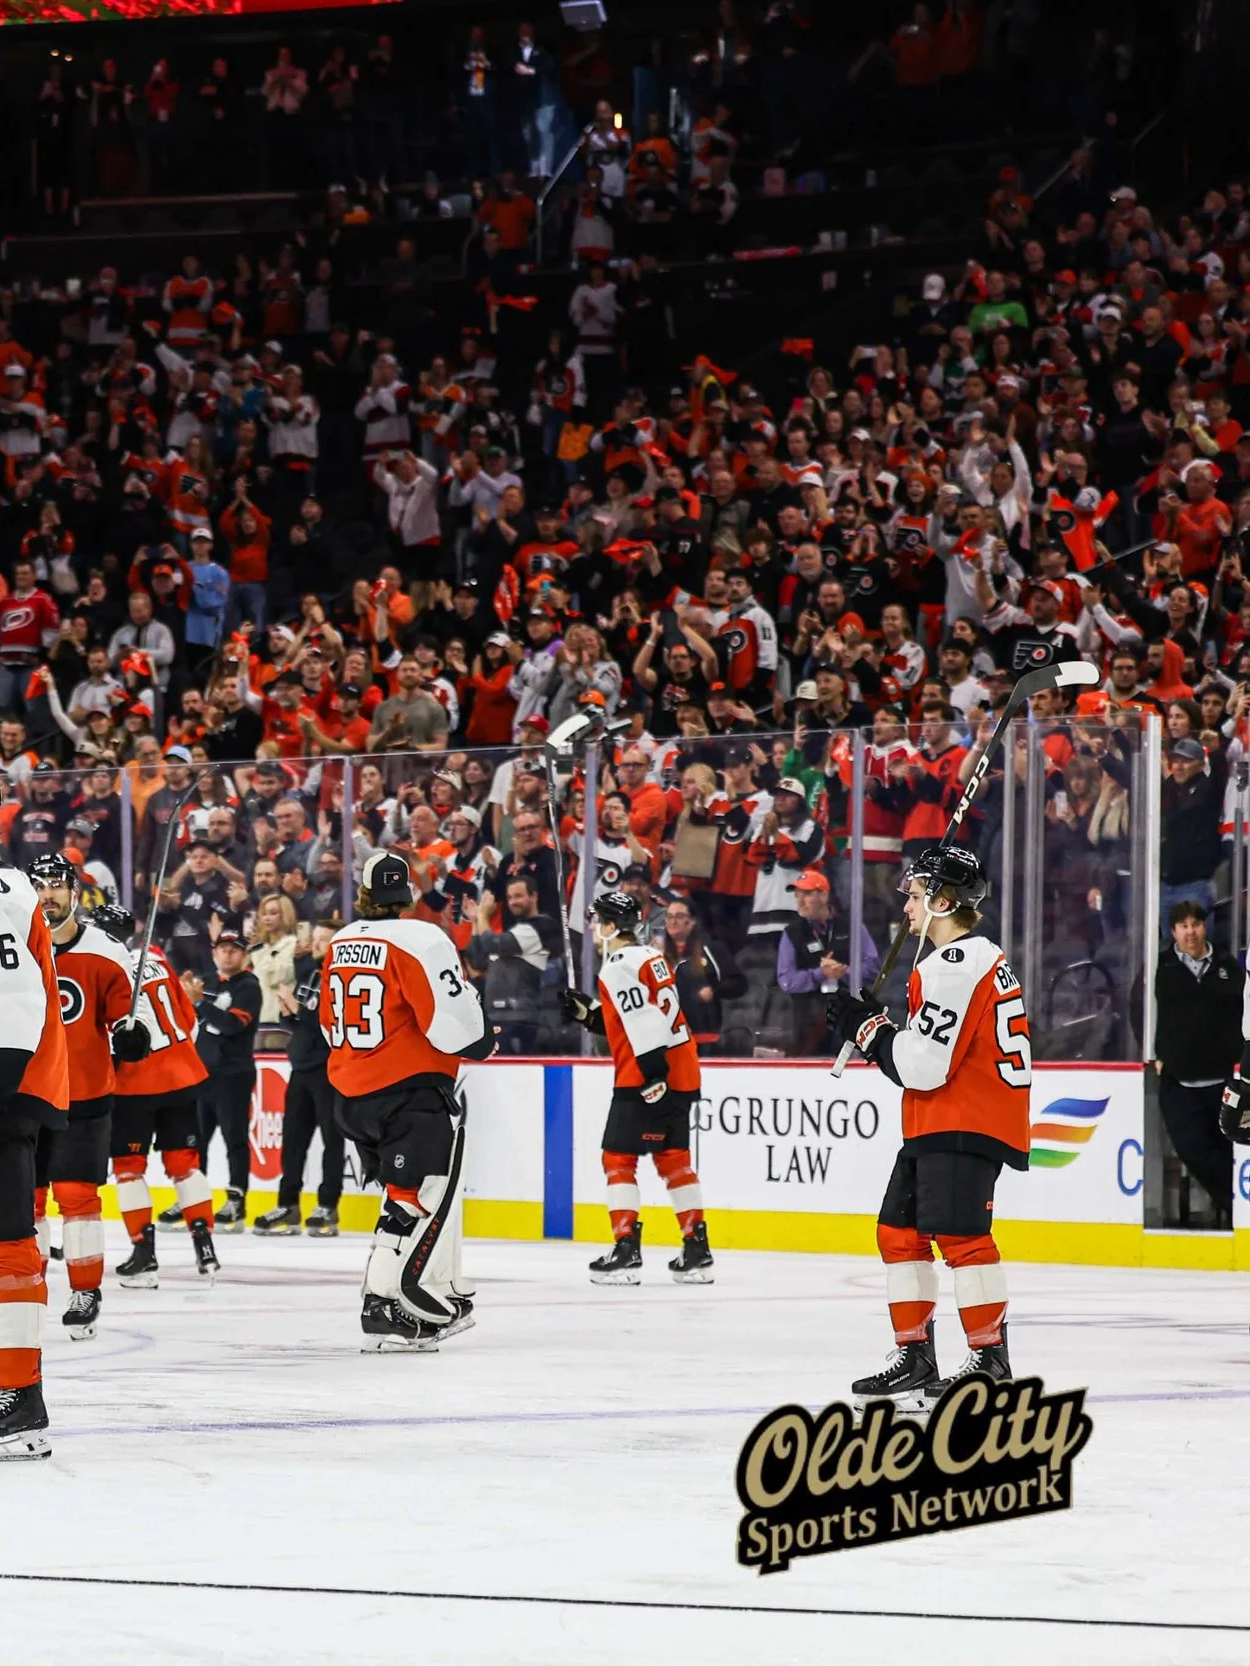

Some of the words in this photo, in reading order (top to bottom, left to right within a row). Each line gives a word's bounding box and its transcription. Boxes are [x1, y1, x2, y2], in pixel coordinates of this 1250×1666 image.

[953, 754, 989, 824] CCM
[333, 944, 382, 966] RSSON
[617, 986, 644, 1013] 20
[918, 1001, 958, 1046] 52
[765, 1145, 833, 1185] LAW
